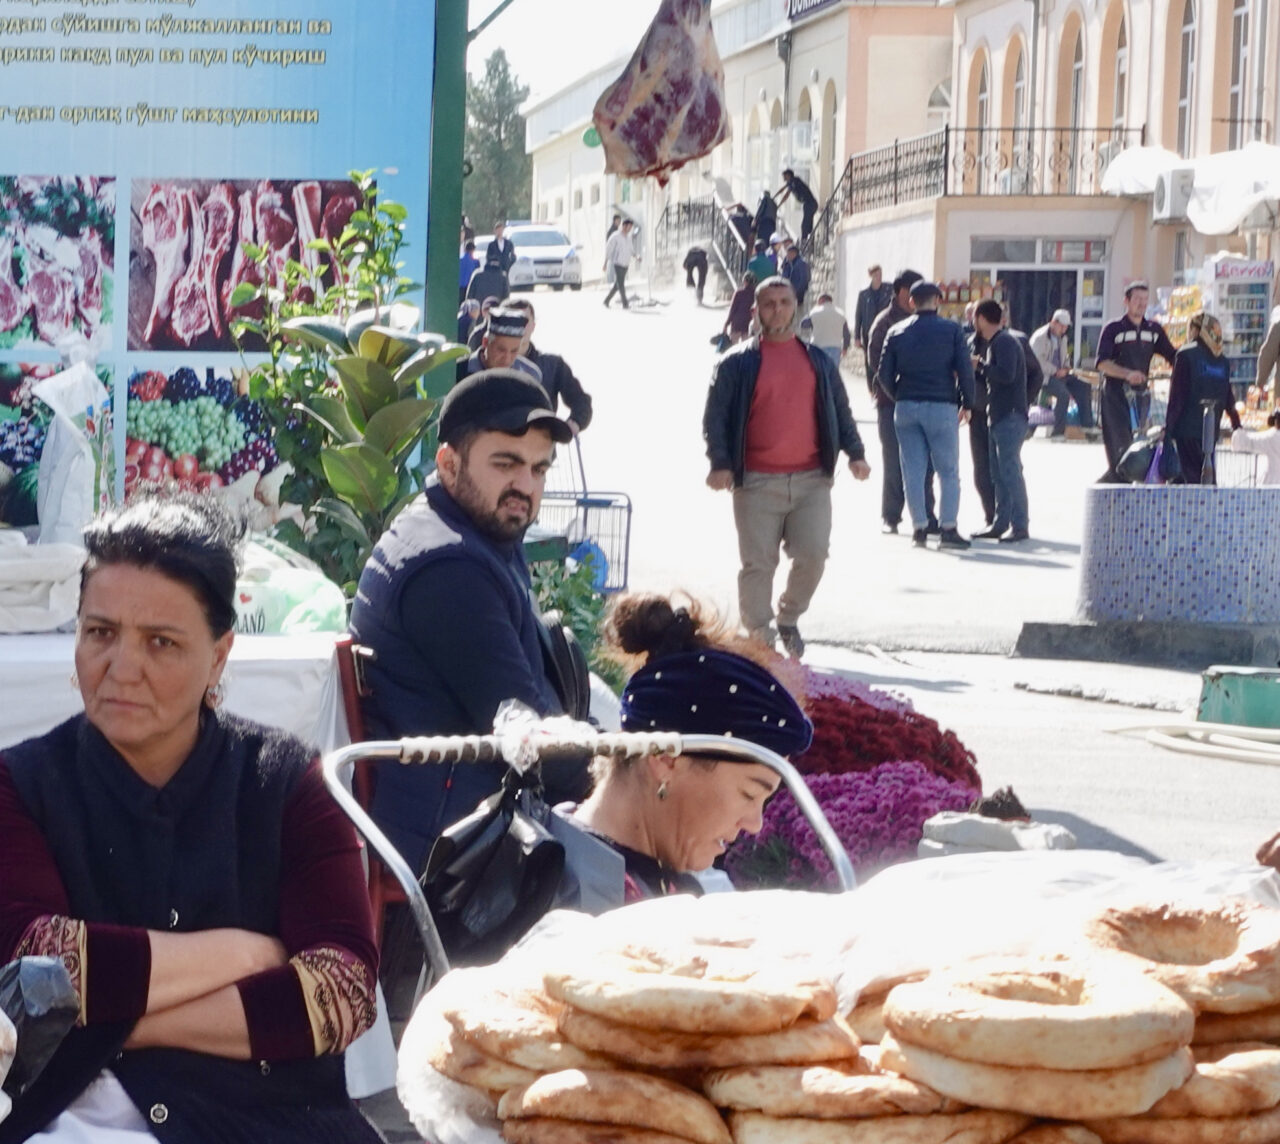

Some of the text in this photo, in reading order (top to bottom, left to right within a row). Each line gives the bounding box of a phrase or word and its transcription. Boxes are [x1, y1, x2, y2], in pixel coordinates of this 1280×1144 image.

[51, 12, 140, 36] сўйишга
[146, 12, 301, 37] мўлжалланган
[307, 19, 332, 35] ва
[116, 47, 153, 67] пул
[159, 48, 183, 64] ва
[189, 48, 227, 68] пул
[233, 44, 326, 68] кўчириш
[126, 102, 178, 126] гўшт
